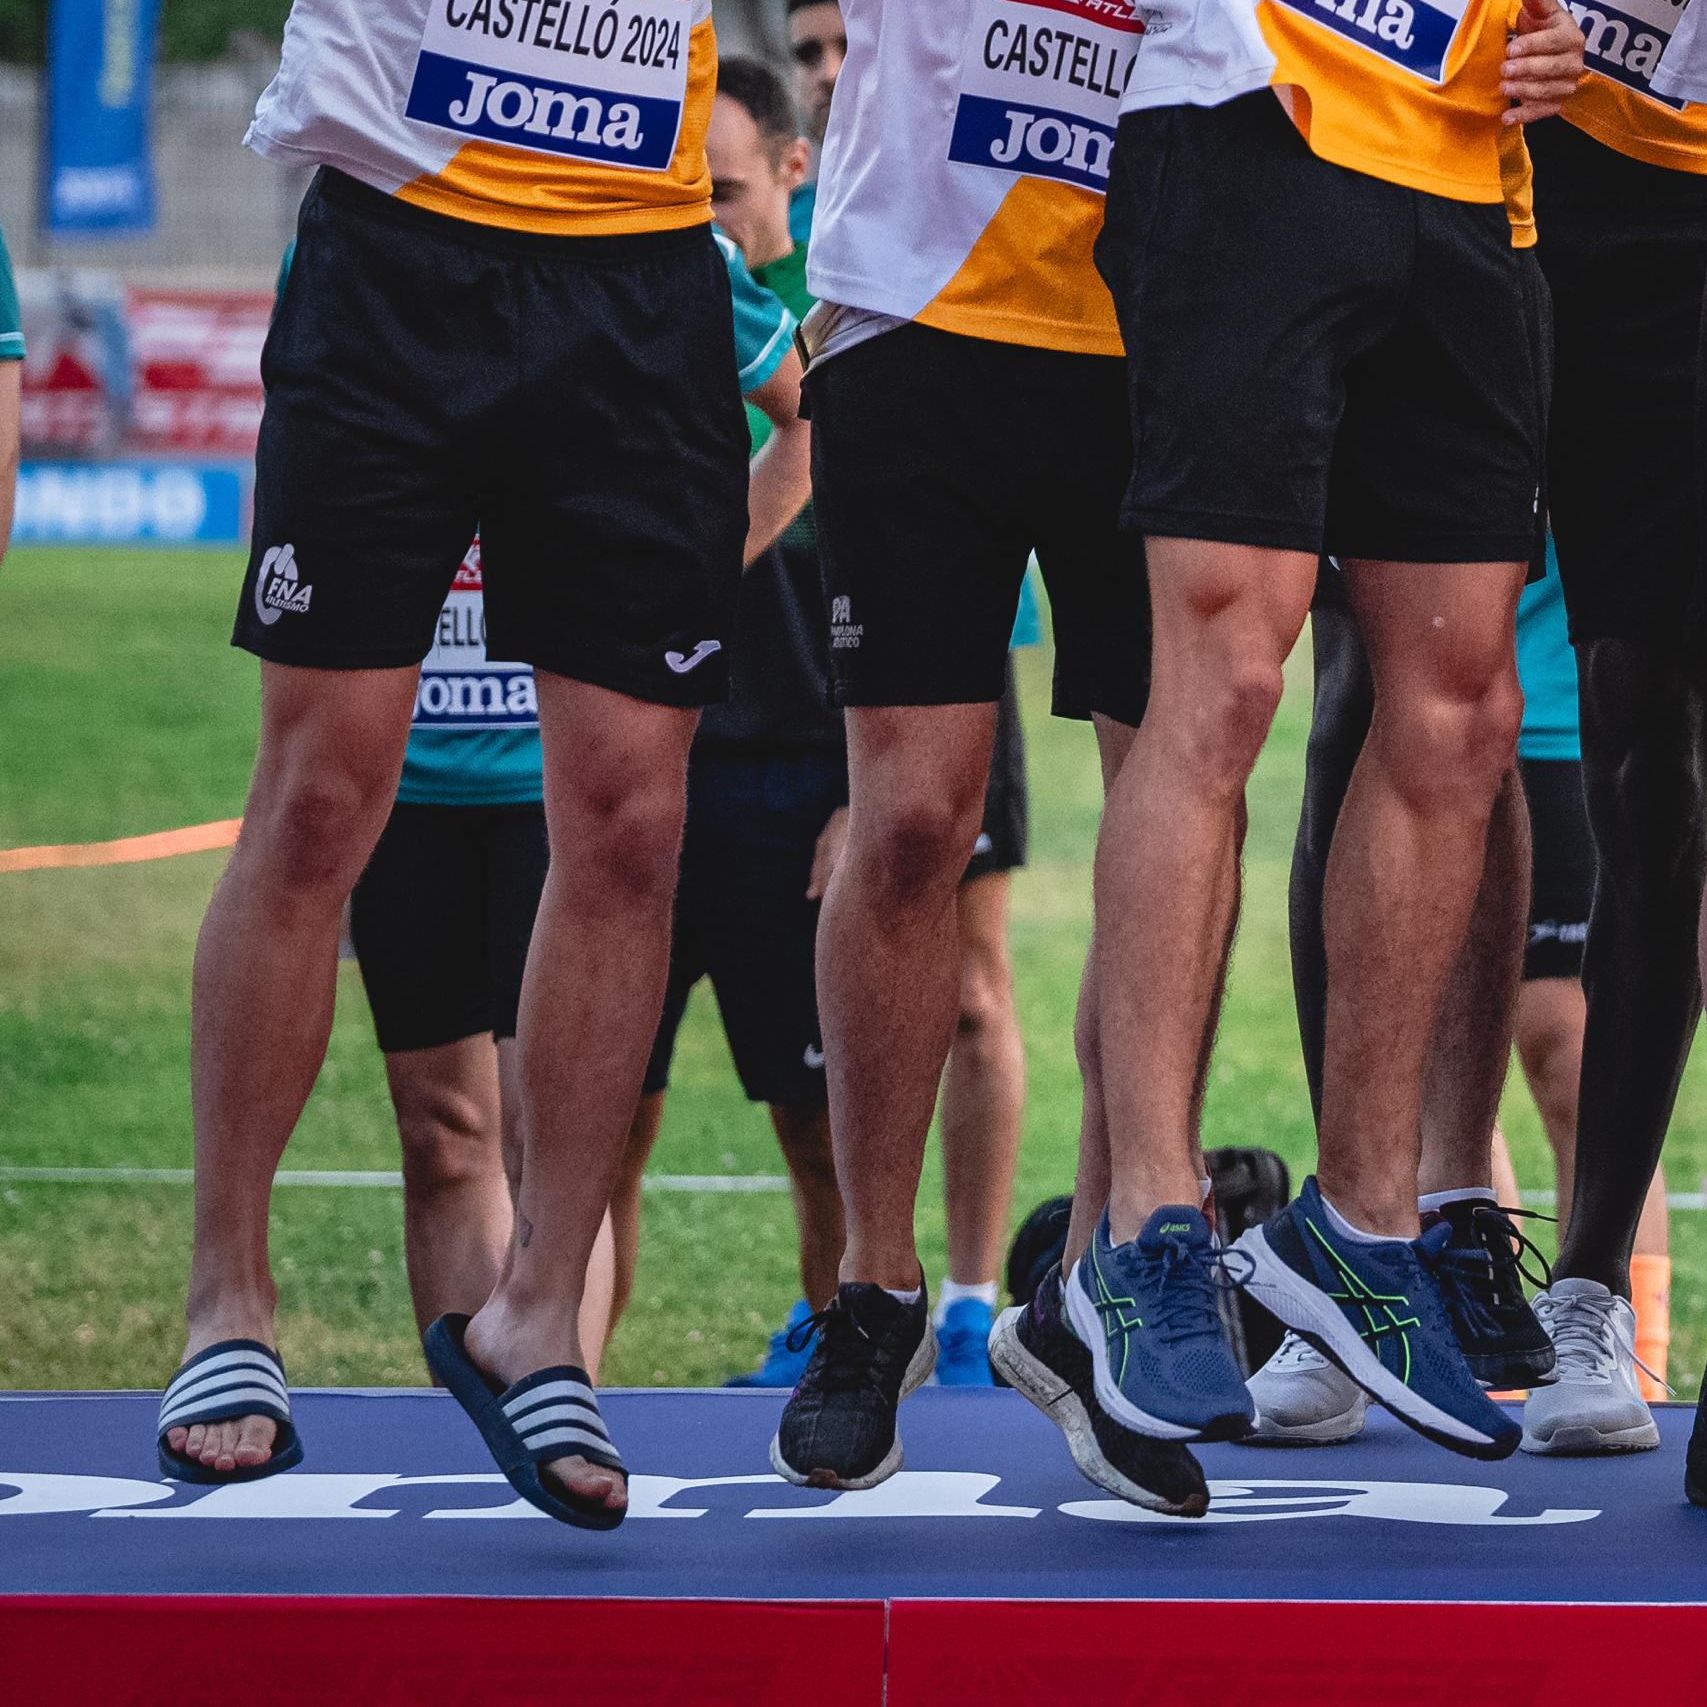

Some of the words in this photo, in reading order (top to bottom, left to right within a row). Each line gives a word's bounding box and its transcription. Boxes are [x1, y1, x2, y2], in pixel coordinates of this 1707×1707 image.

[619, 14, 681, 70] 2024
[984, 19, 1136, 98] CASTELL
[448, 70, 644, 150] Joma
[990, 110, 1116, 176] Jom
[267, 577, 313, 605] FNA
[413, 675, 539, 718] oma
[0, 1472, 1602, 1526] ma
